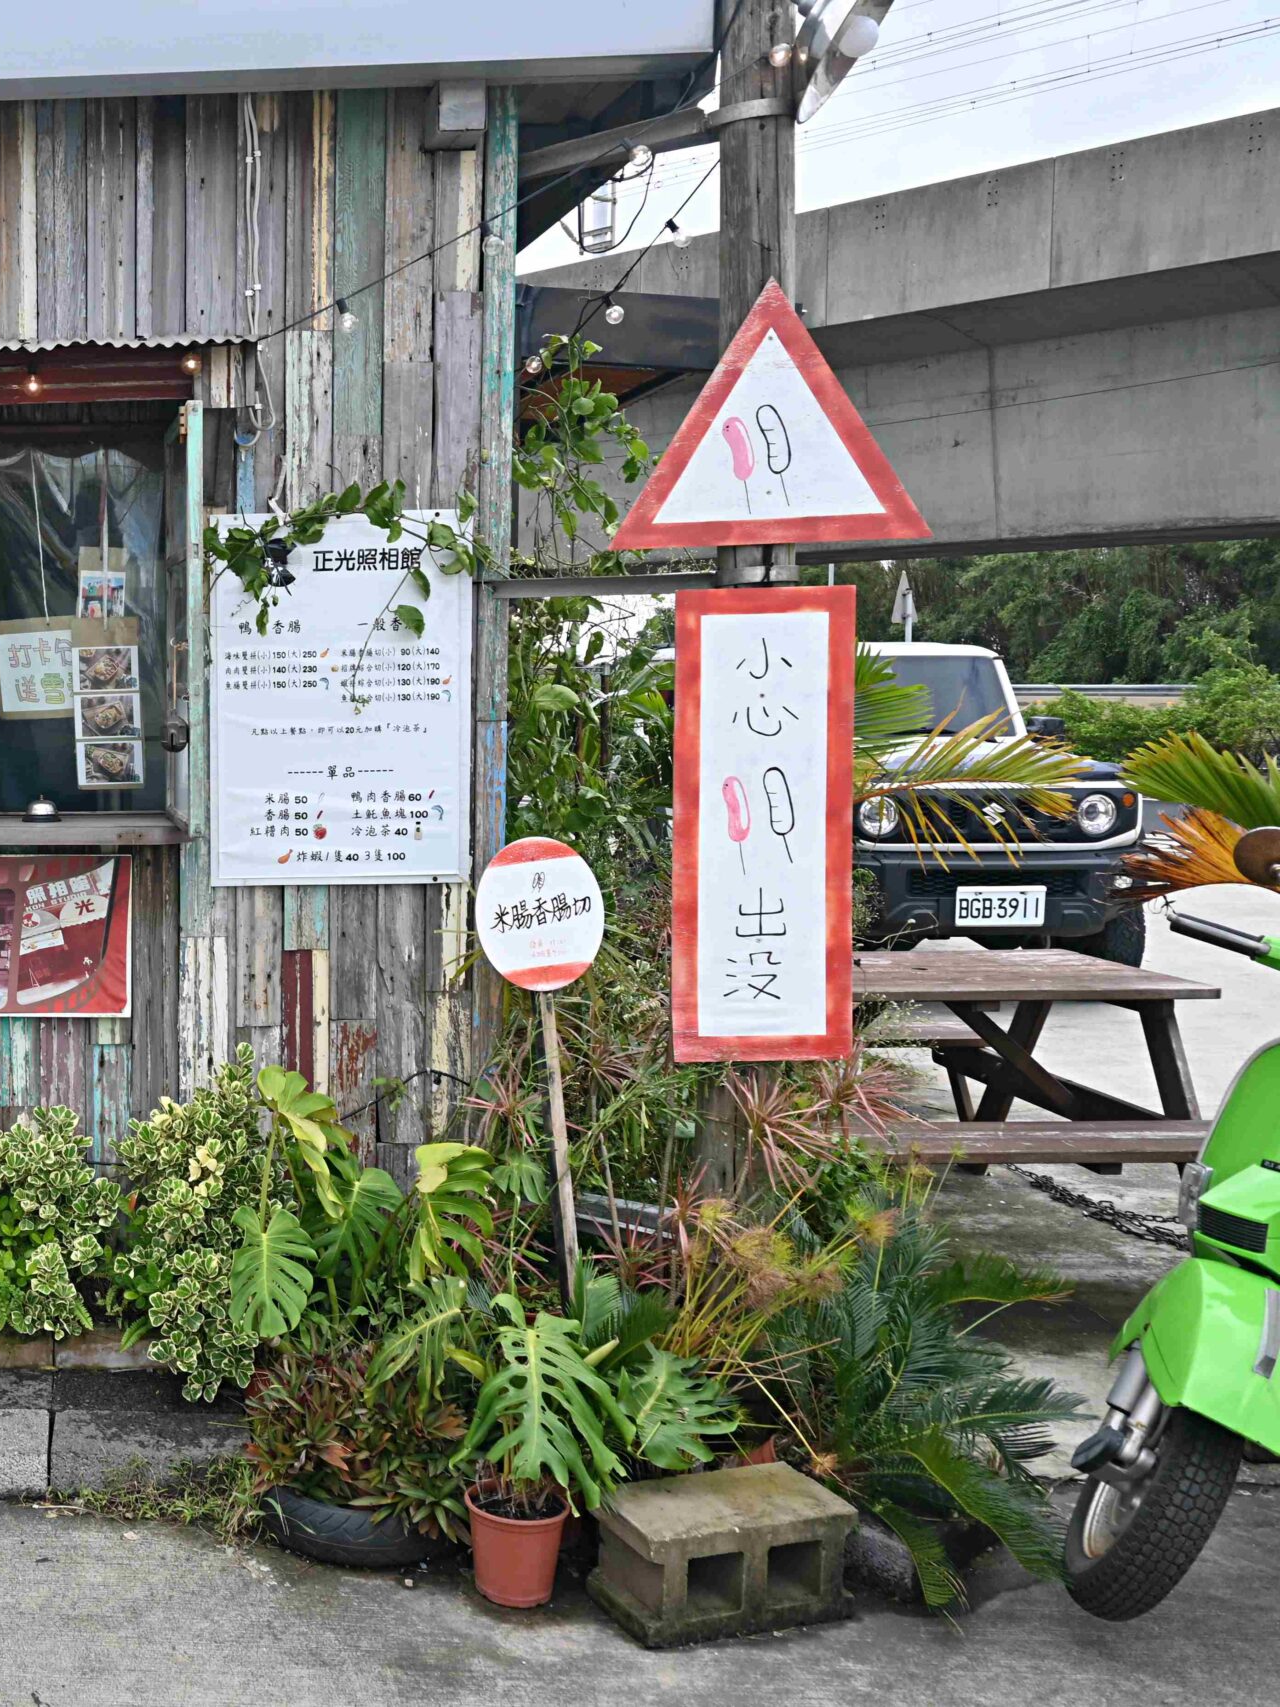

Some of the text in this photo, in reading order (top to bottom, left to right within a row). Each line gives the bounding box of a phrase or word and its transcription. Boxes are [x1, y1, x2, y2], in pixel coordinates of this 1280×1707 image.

[312, 547, 421, 572] 正光照相館
[239, 618, 301, 635] 鴨香腸
[357, 616, 416, 632] 一般香
[732, 637, 799, 737] 小心
[294, 795, 308, 804] 50
[294, 812, 308, 820] 50
[295, 828, 308, 836] 50
[74, 898, 96, 916] 光
[490, 892, 592, 934] 米腸香腸切
